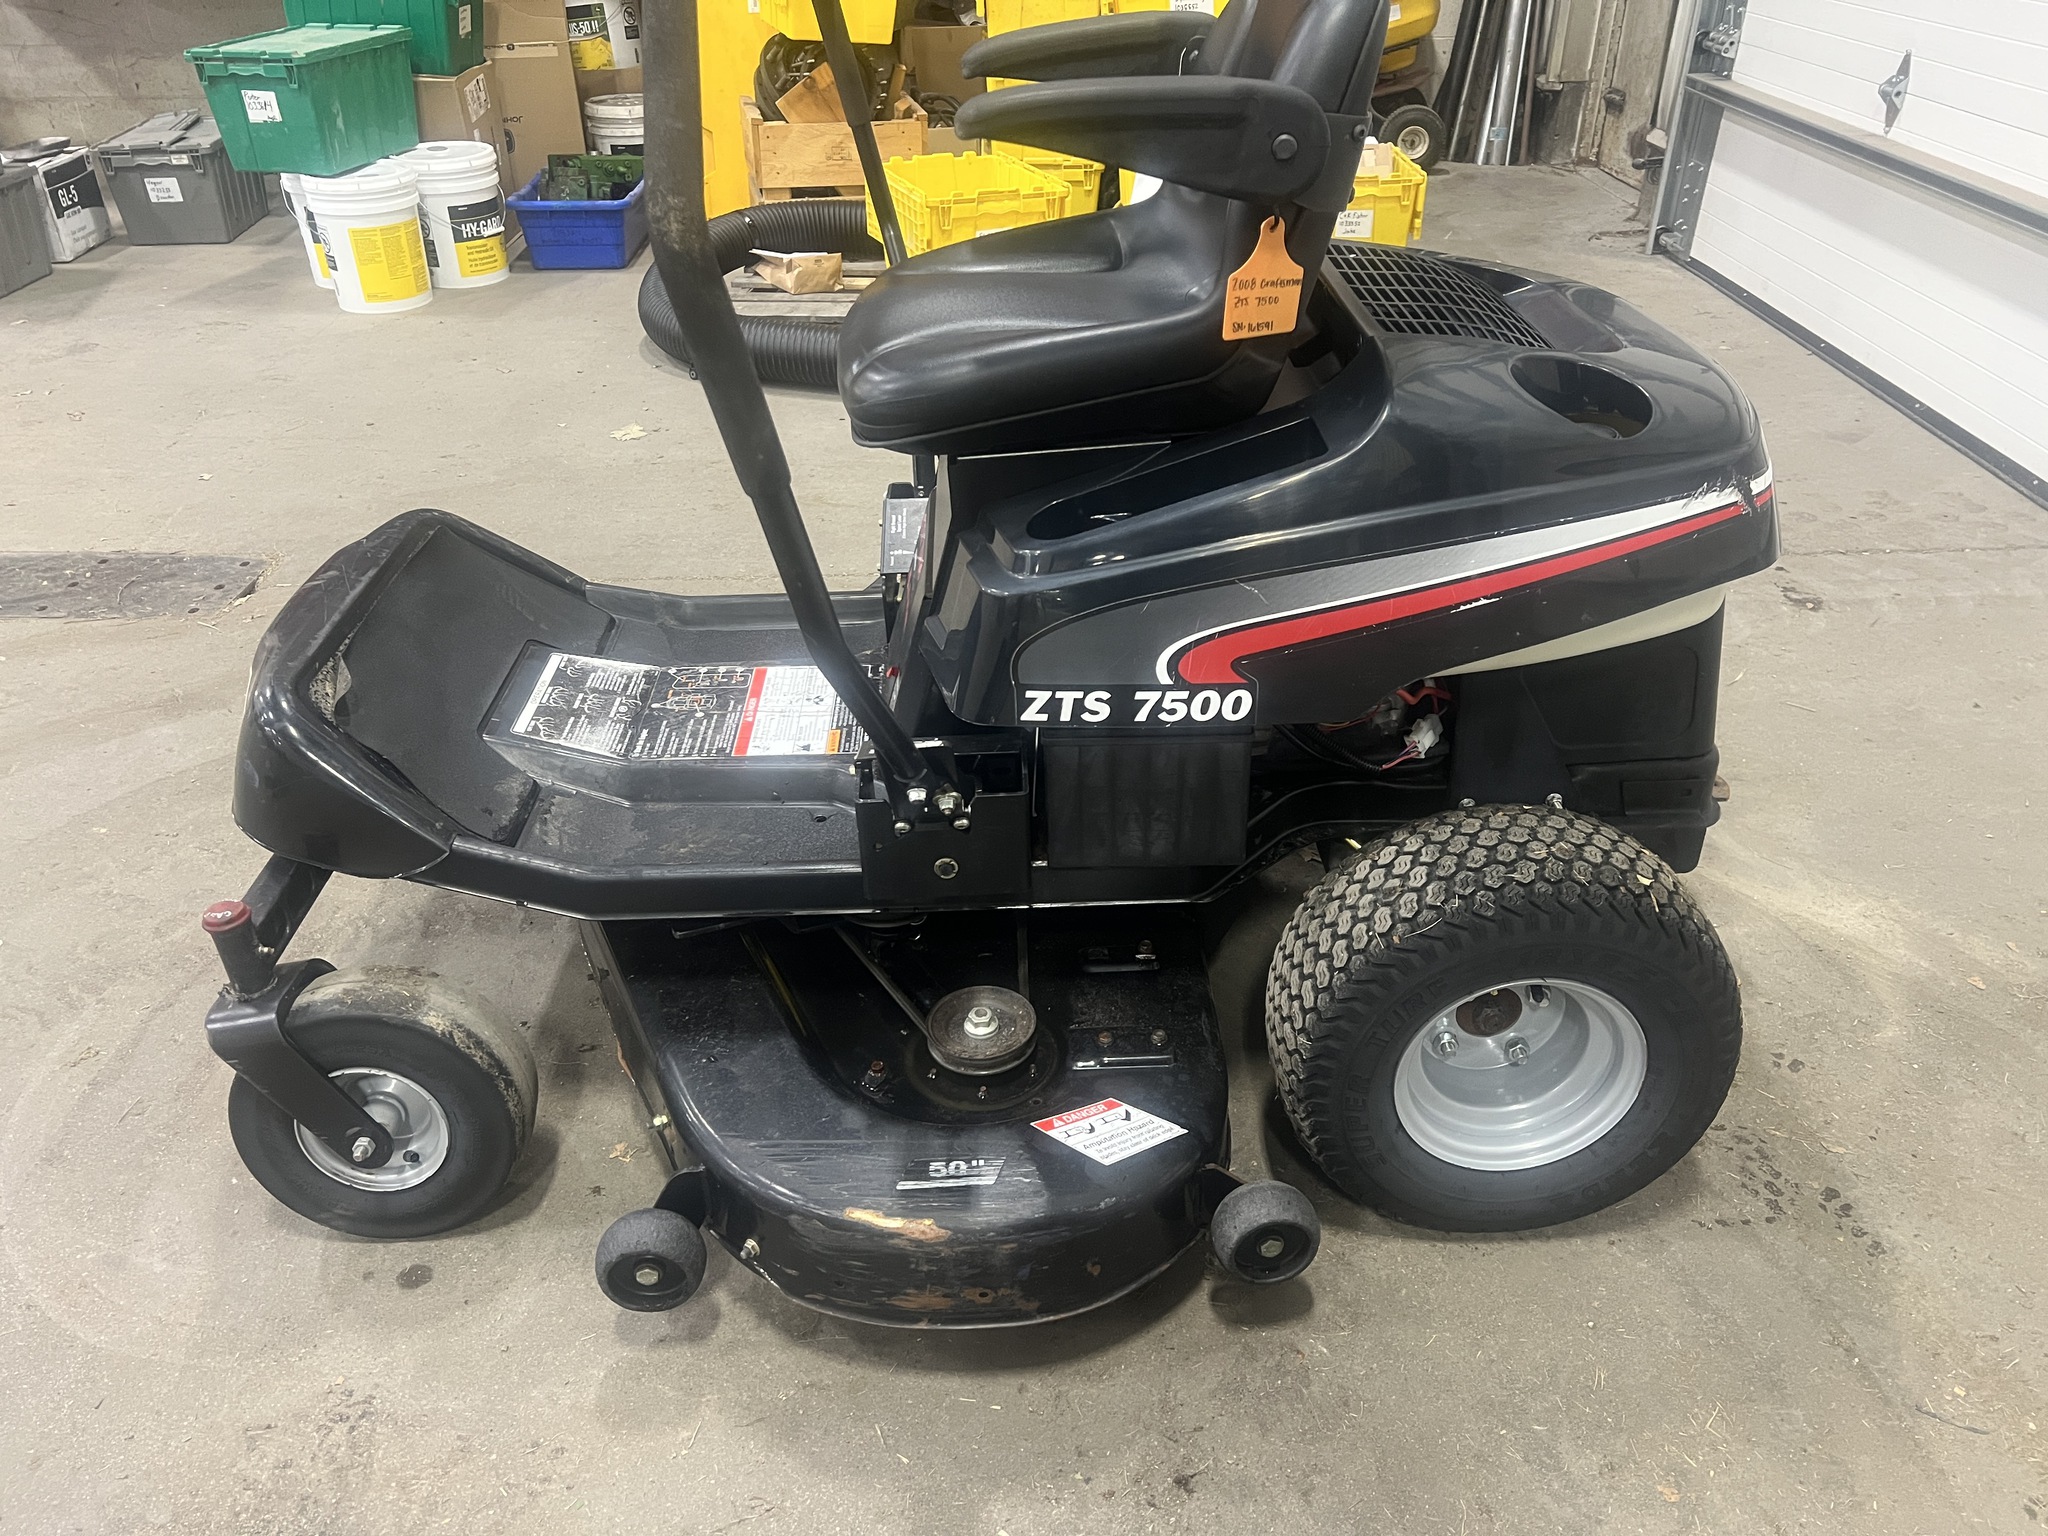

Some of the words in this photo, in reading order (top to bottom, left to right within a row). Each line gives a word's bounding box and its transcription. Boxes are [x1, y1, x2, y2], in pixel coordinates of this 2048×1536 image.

[58, 184, 79, 207] GL-5
[1232, 277, 1257, 291] 2008
[1255, 296, 1280, 308] 7500
[1020, 690, 1112, 722] ZTS
[1134, 689, 1253, 723] 7500
[1061, 1103, 1108, 1124] DANGER
[1083, 1129, 1128, 1151] Amputation
[1127, 1118, 1155, 1134] Hazard
